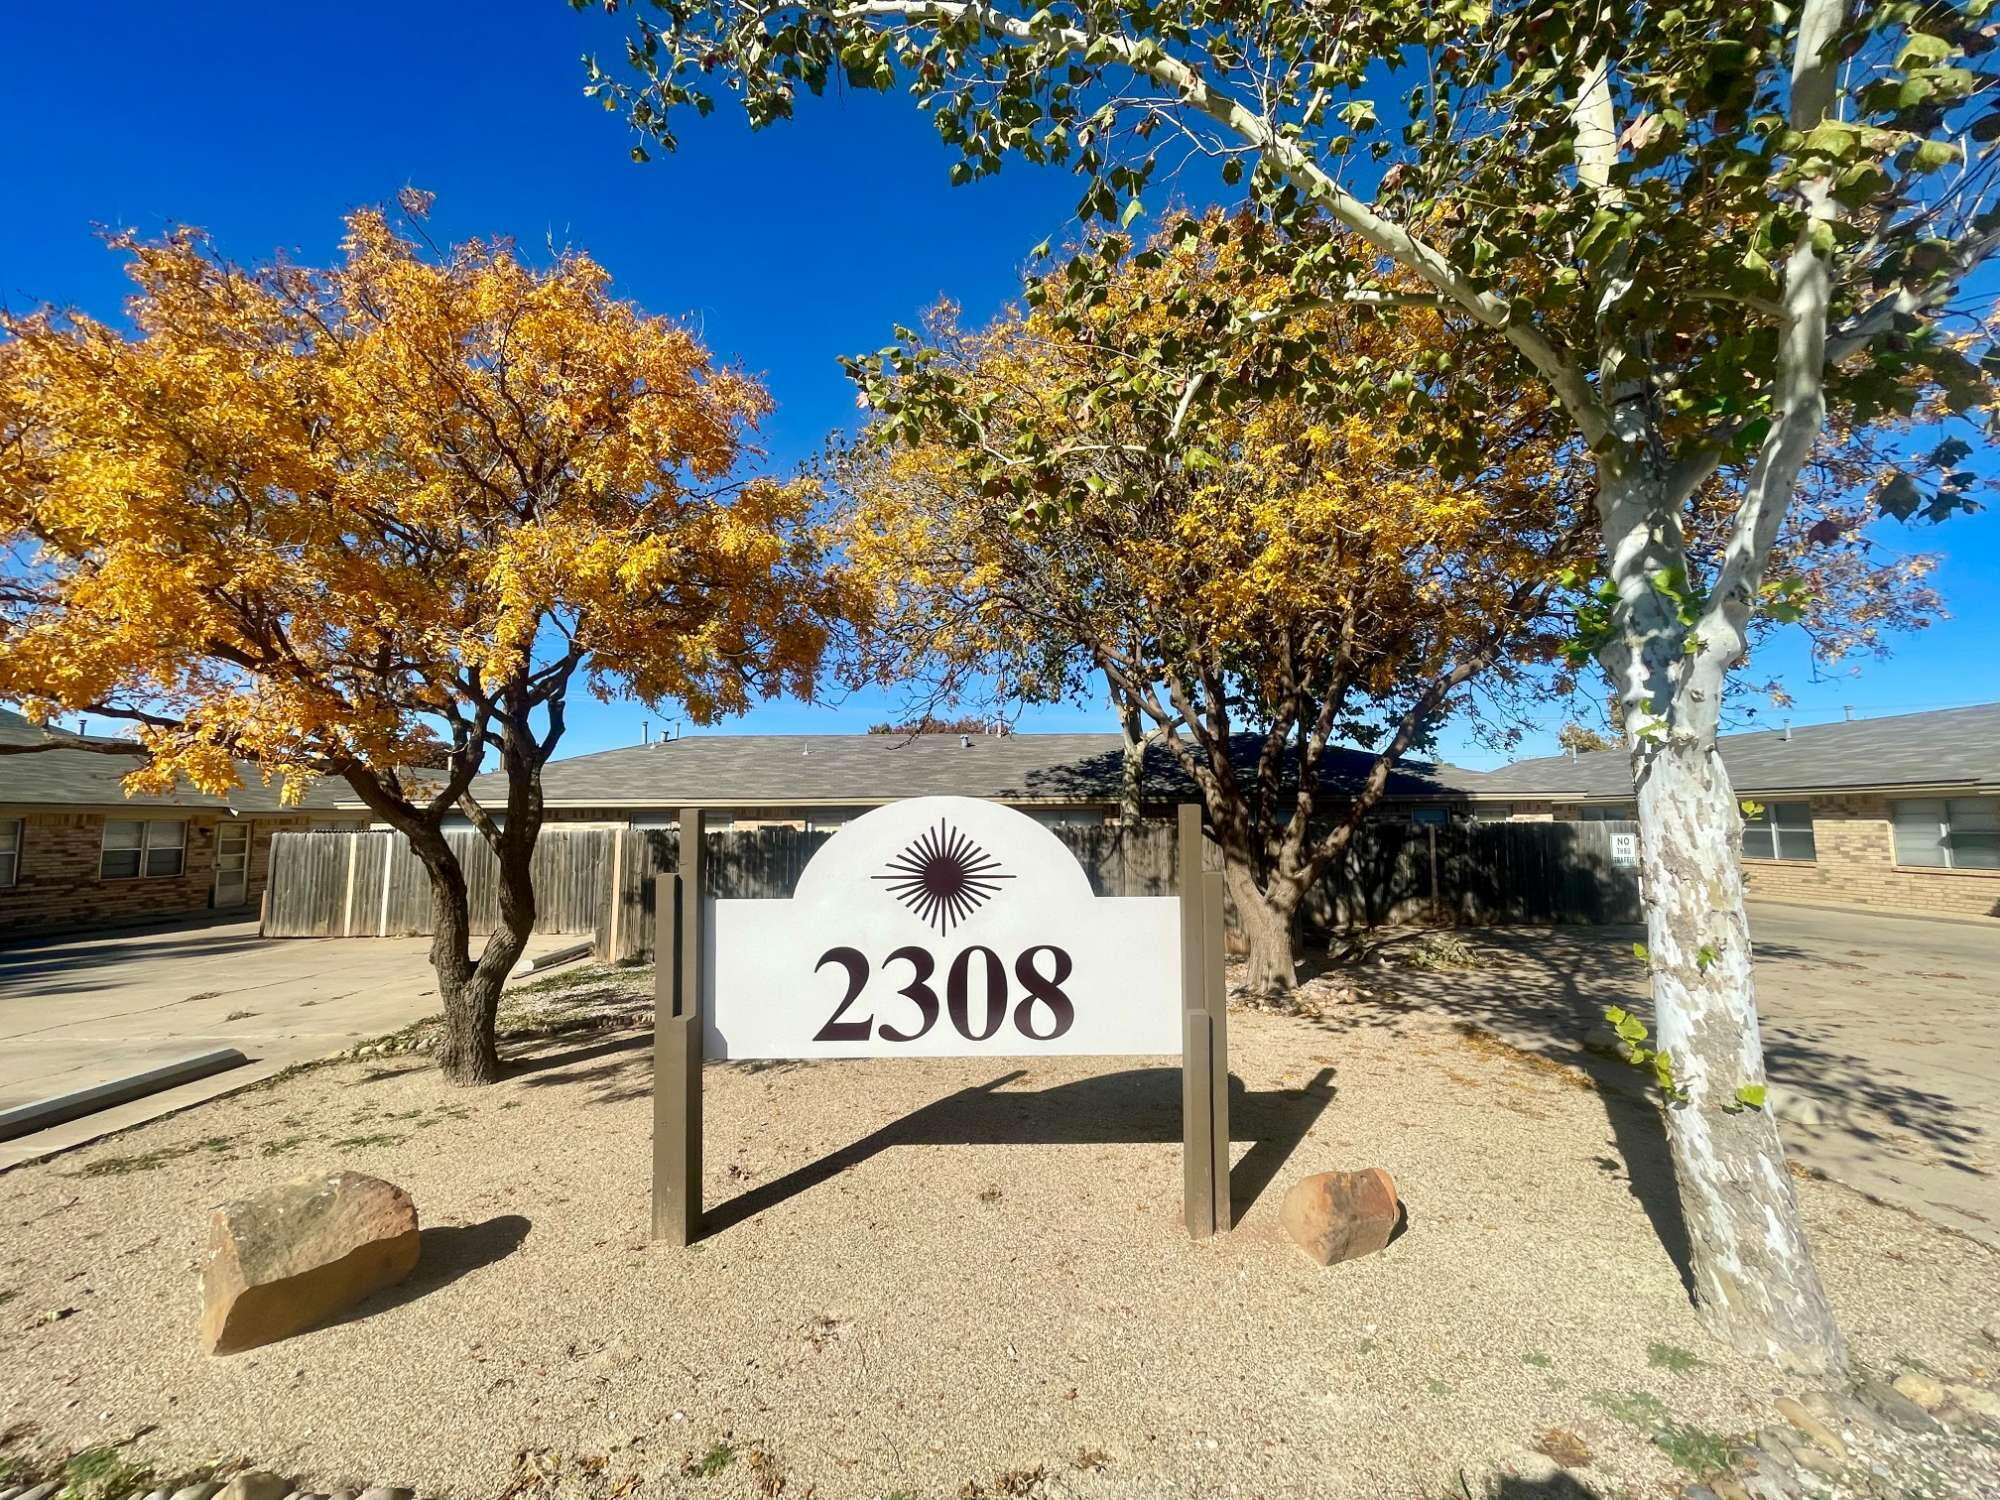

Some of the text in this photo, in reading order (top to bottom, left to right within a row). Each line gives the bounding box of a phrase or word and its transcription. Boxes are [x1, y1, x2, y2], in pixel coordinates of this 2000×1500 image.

[1617, 837, 1630, 846] NO
[1613, 856, 1635, 864] TRAFFIC
[813, 945, 1074, 1042] 2308
